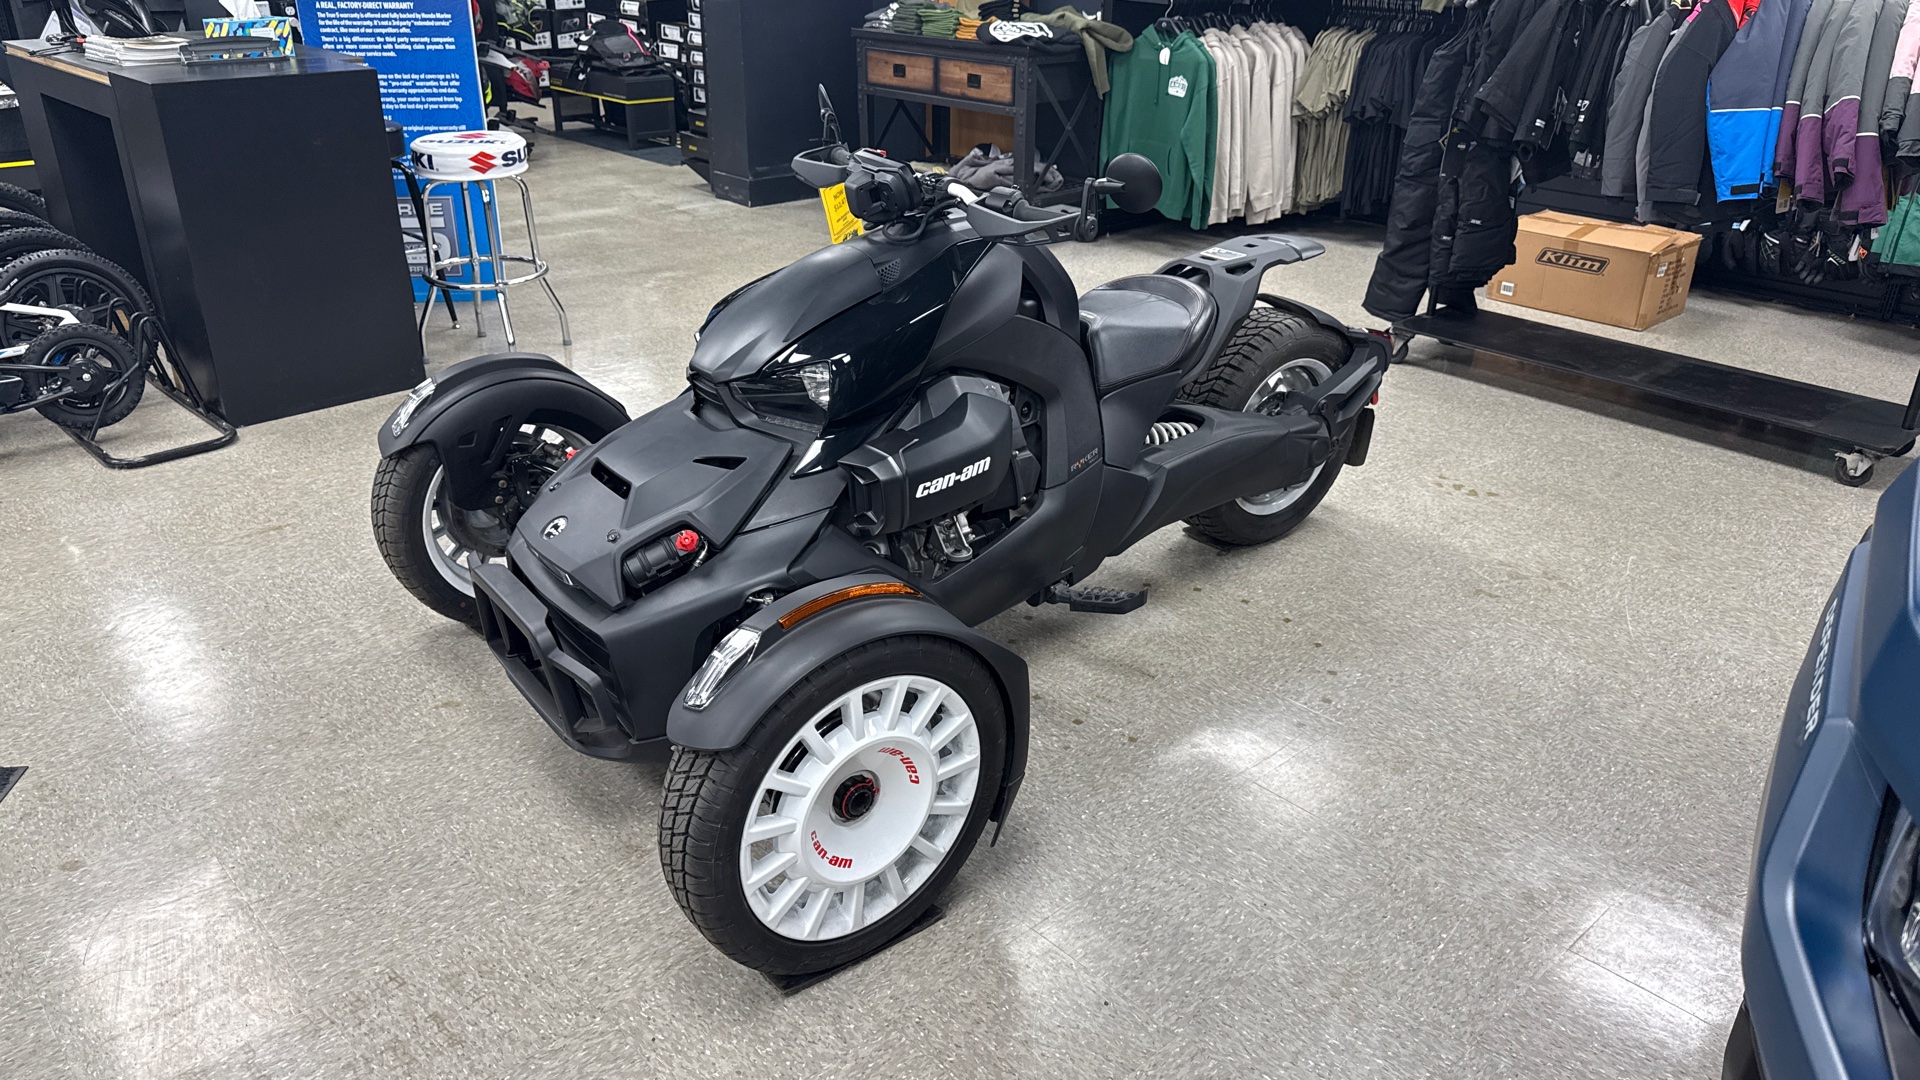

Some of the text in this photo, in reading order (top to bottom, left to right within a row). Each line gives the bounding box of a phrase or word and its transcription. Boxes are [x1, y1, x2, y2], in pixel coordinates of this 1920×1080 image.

[321, 2, 337, 10] REAL,
[916, 456, 991, 498] can-am
[1804, 597, 1838, 740] DEFENDER
[878, 746, 920, 785] can-am
[810, 830, 853, 868] can-am
